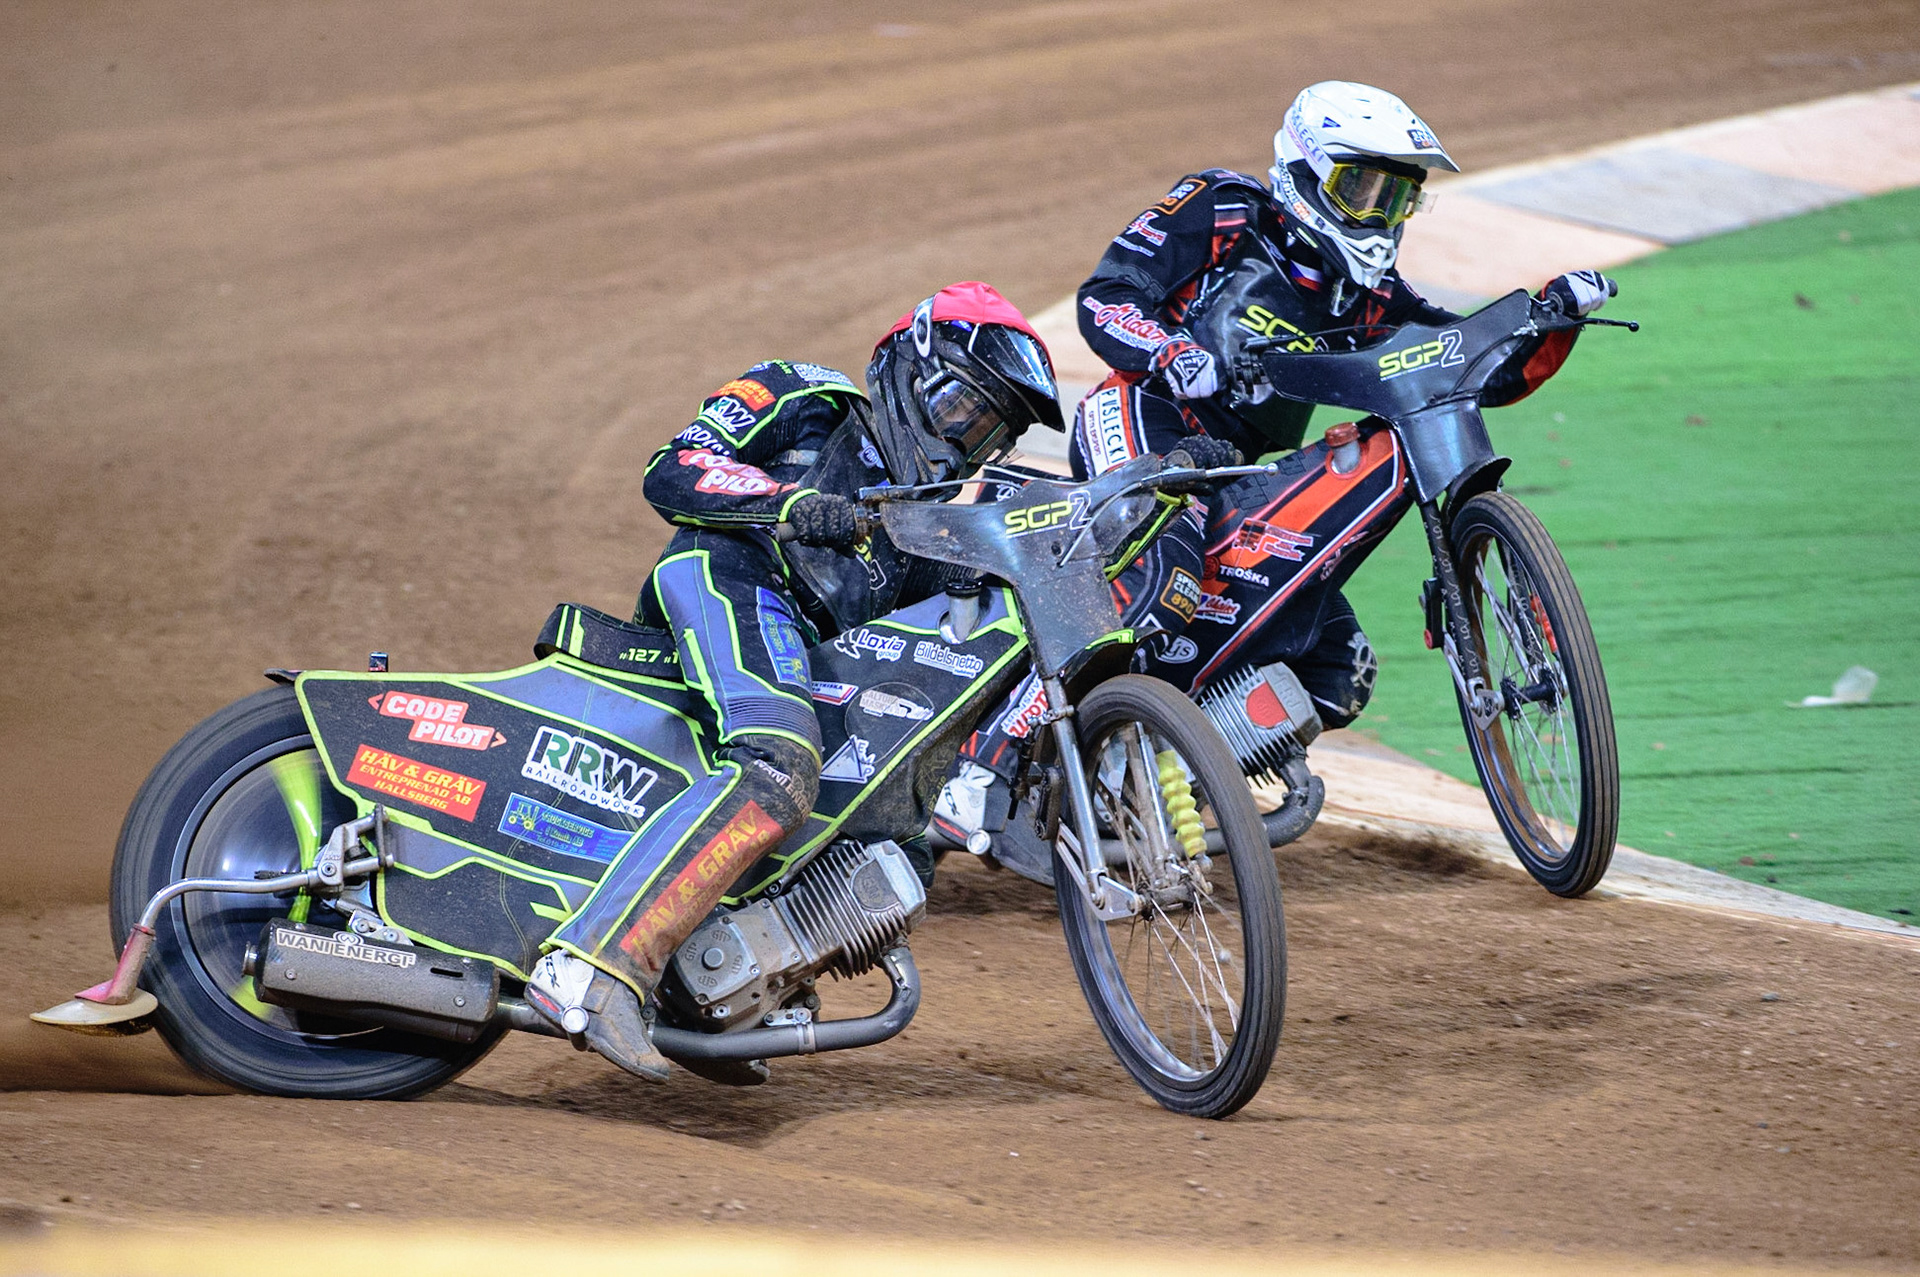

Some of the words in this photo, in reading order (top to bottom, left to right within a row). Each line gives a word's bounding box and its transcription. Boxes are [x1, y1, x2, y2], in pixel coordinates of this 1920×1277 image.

[1378, 329, 1465, 377] SGP2
[1004, 490, 1091, 534] SGP2
[857, 630, 905, 651] Loxia
[916, 643, 982, 671] Bildelsnetto
[386, 695, 463, 723] CODE
[414, 721, 489, 747] PILOT
[359, 750, 404, 772] HÄV
[403, 764, 421, 779] &
[423, 769, 481, 796] GRÄV
[359, 765, 450, 798] ENTREPRENAD
[450, 793, 472, 806] AB
[531, 730, 655, 802] RRW
[374, 780, 449, 810] HALLSBERG
[697, 810, 759, 883] GRÄV
